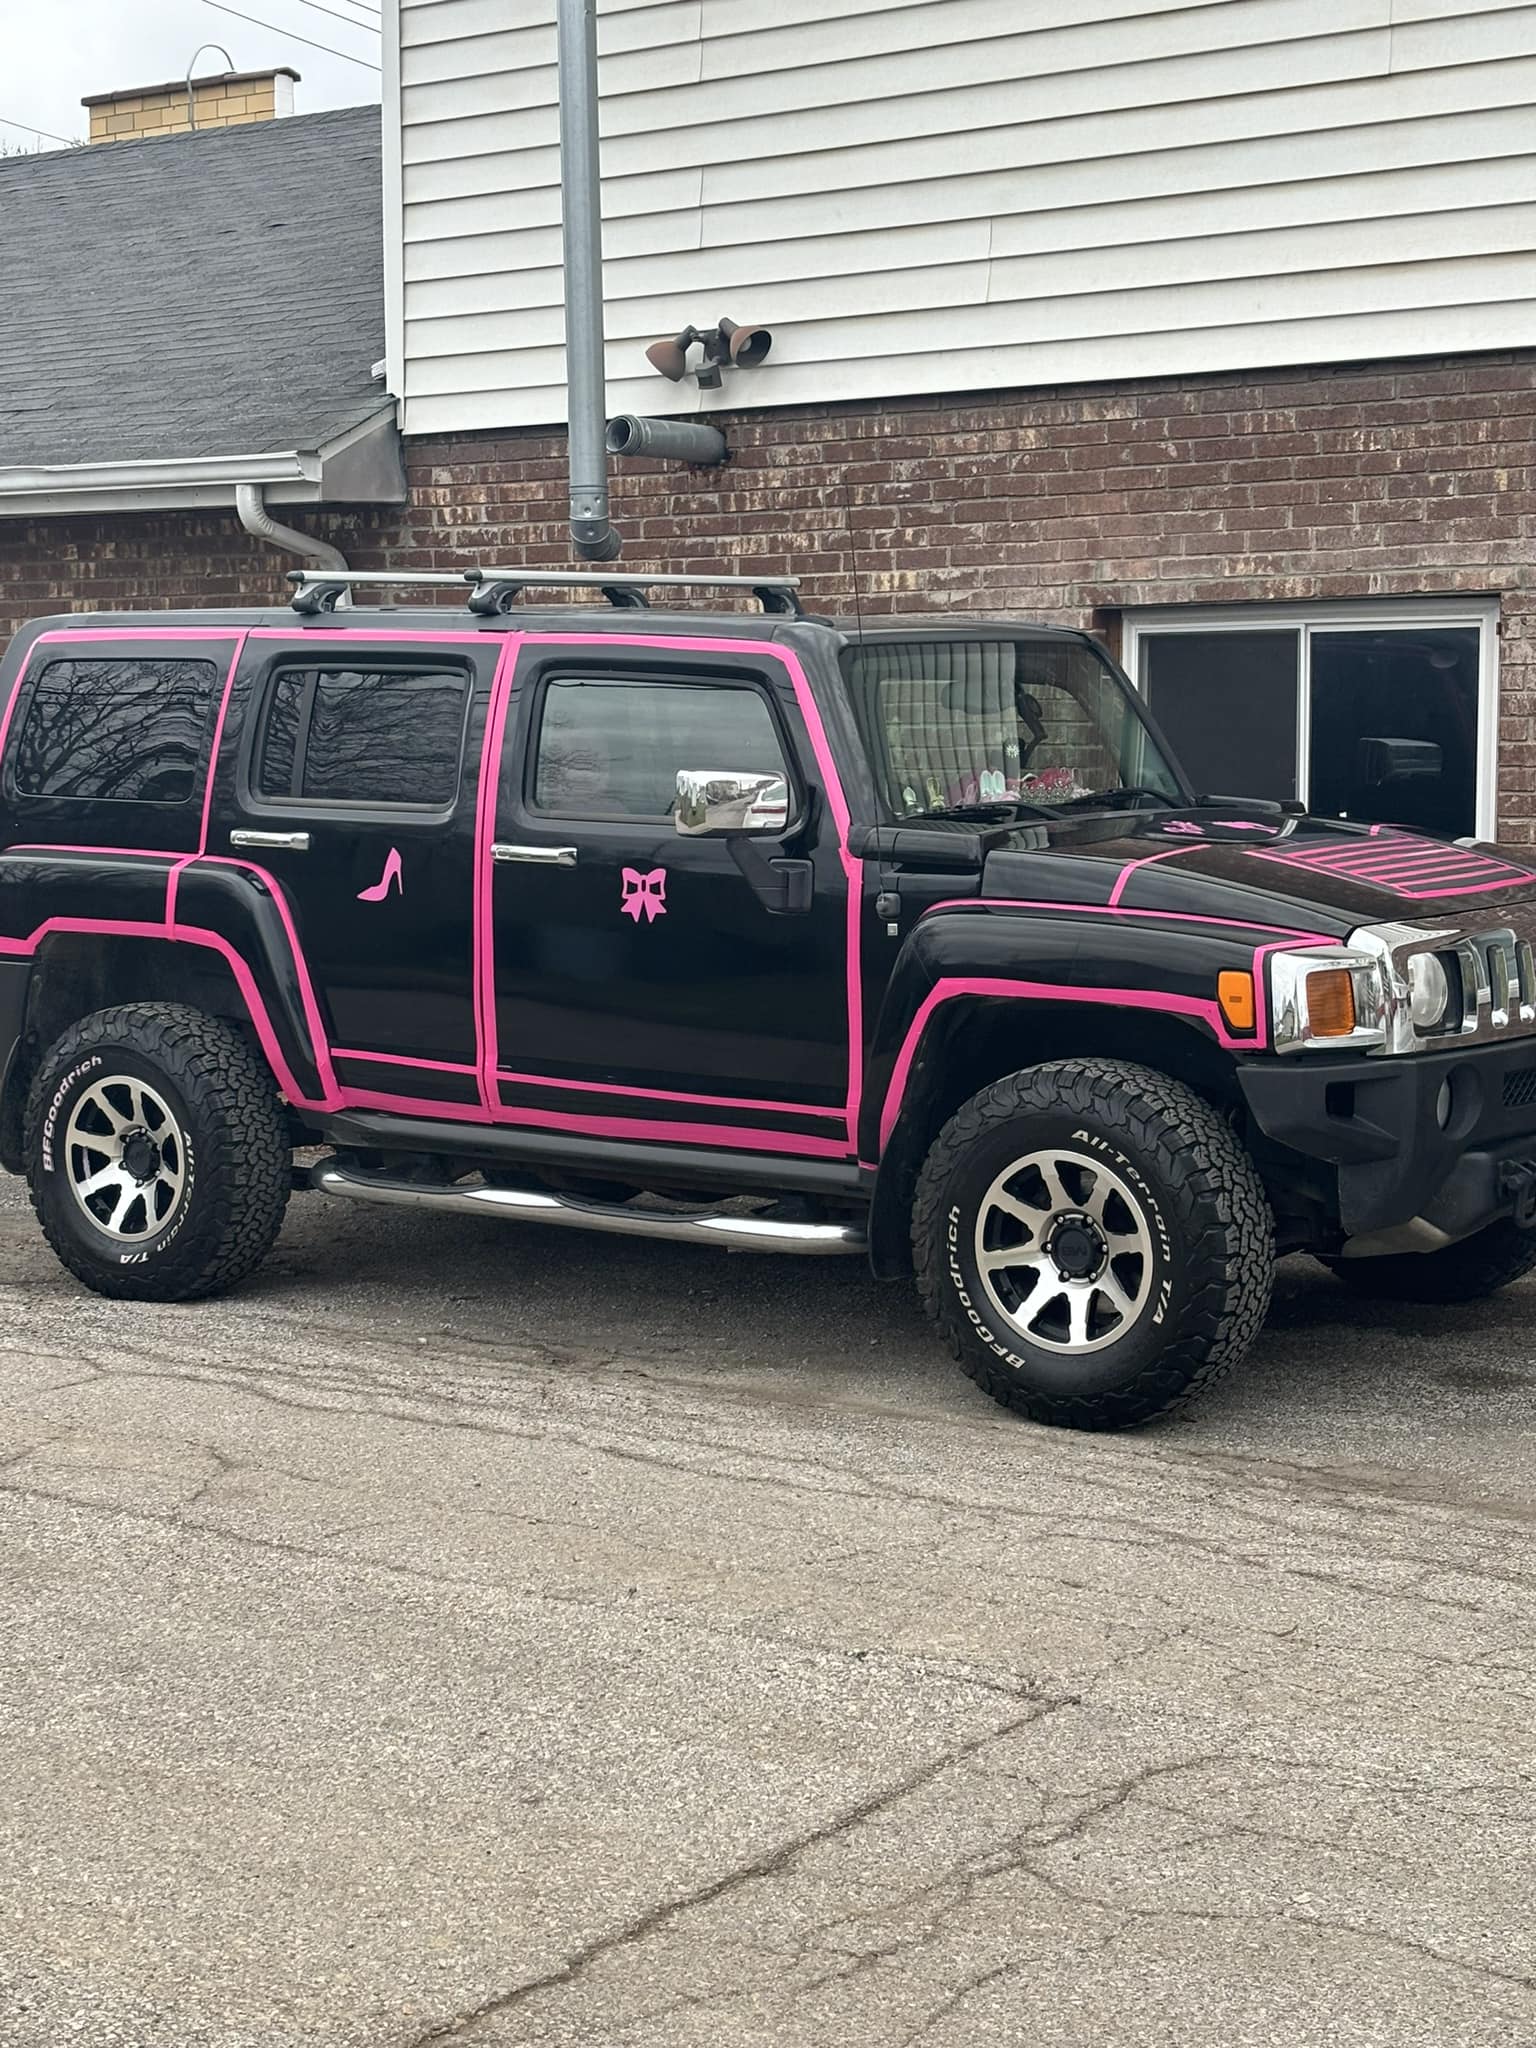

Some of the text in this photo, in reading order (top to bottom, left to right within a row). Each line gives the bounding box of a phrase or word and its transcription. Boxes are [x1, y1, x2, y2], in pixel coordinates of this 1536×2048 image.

[42, 1055, 102, 1172] BFGoodrich
[120, 1252, 149, 1264] T/A
[946, 1205, 1026, 1369] BFGoodrich
[1071, 1129, 1170, 1262] All-Terrain
[1152, 1279, 1173, 1325] T/A
